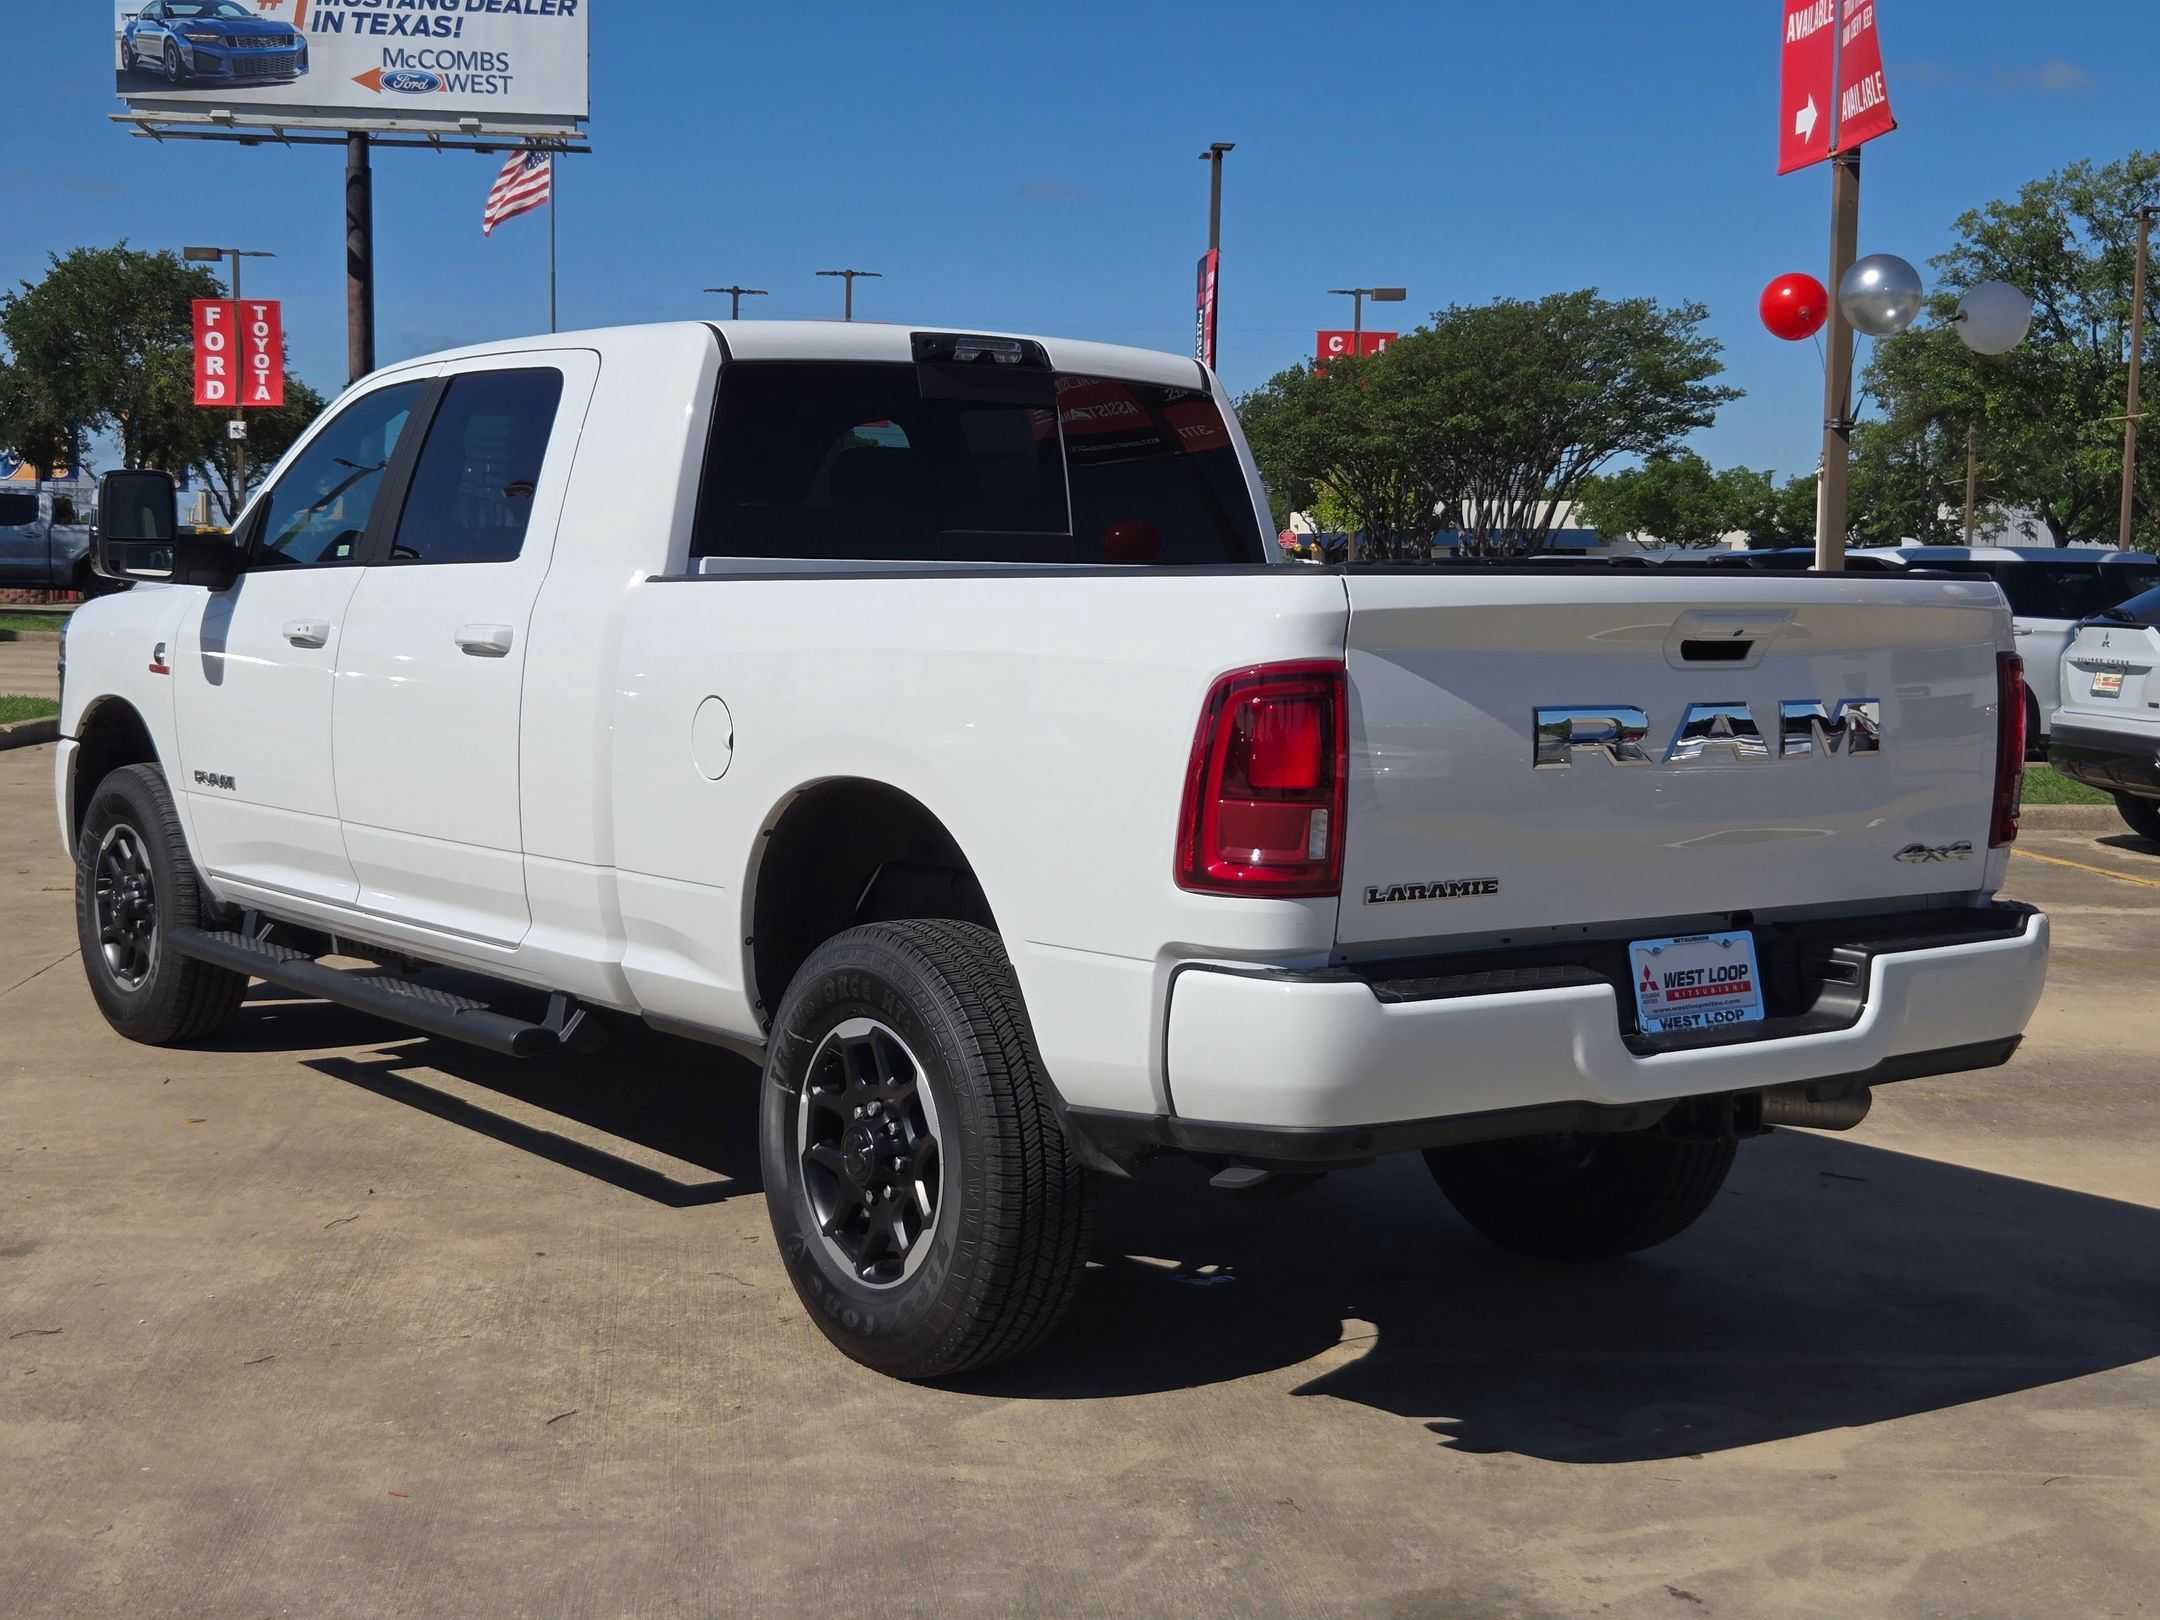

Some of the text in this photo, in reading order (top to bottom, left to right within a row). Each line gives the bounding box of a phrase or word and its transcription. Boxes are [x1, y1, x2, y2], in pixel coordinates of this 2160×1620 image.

[311, 10, 345, 33] IN
[351, 12, 464, 38] TEXAS!
[1786, 0, 1834, 43] AVAILABLE
[382, 47, 510, 73] McCOMBS
[392, 72, 513, 95] Ford WEST
[1842, 70, 1885, 122] AVAILABLE
[205, 307, 226, 399] FORD
[253, 305, 271, 400] TOYOTA
[1532, 697, 1881, 770] RAM
[194, 770, 236, 791] RAM
[1364, 878, 1499, 905] LARAMIE
[1663, 963, 1748, 989] WEST LOOP
[1674, 985, 1745, 998] MITSUBISHI
[1659, 1009, 1745, 1030] WEST LOOP
